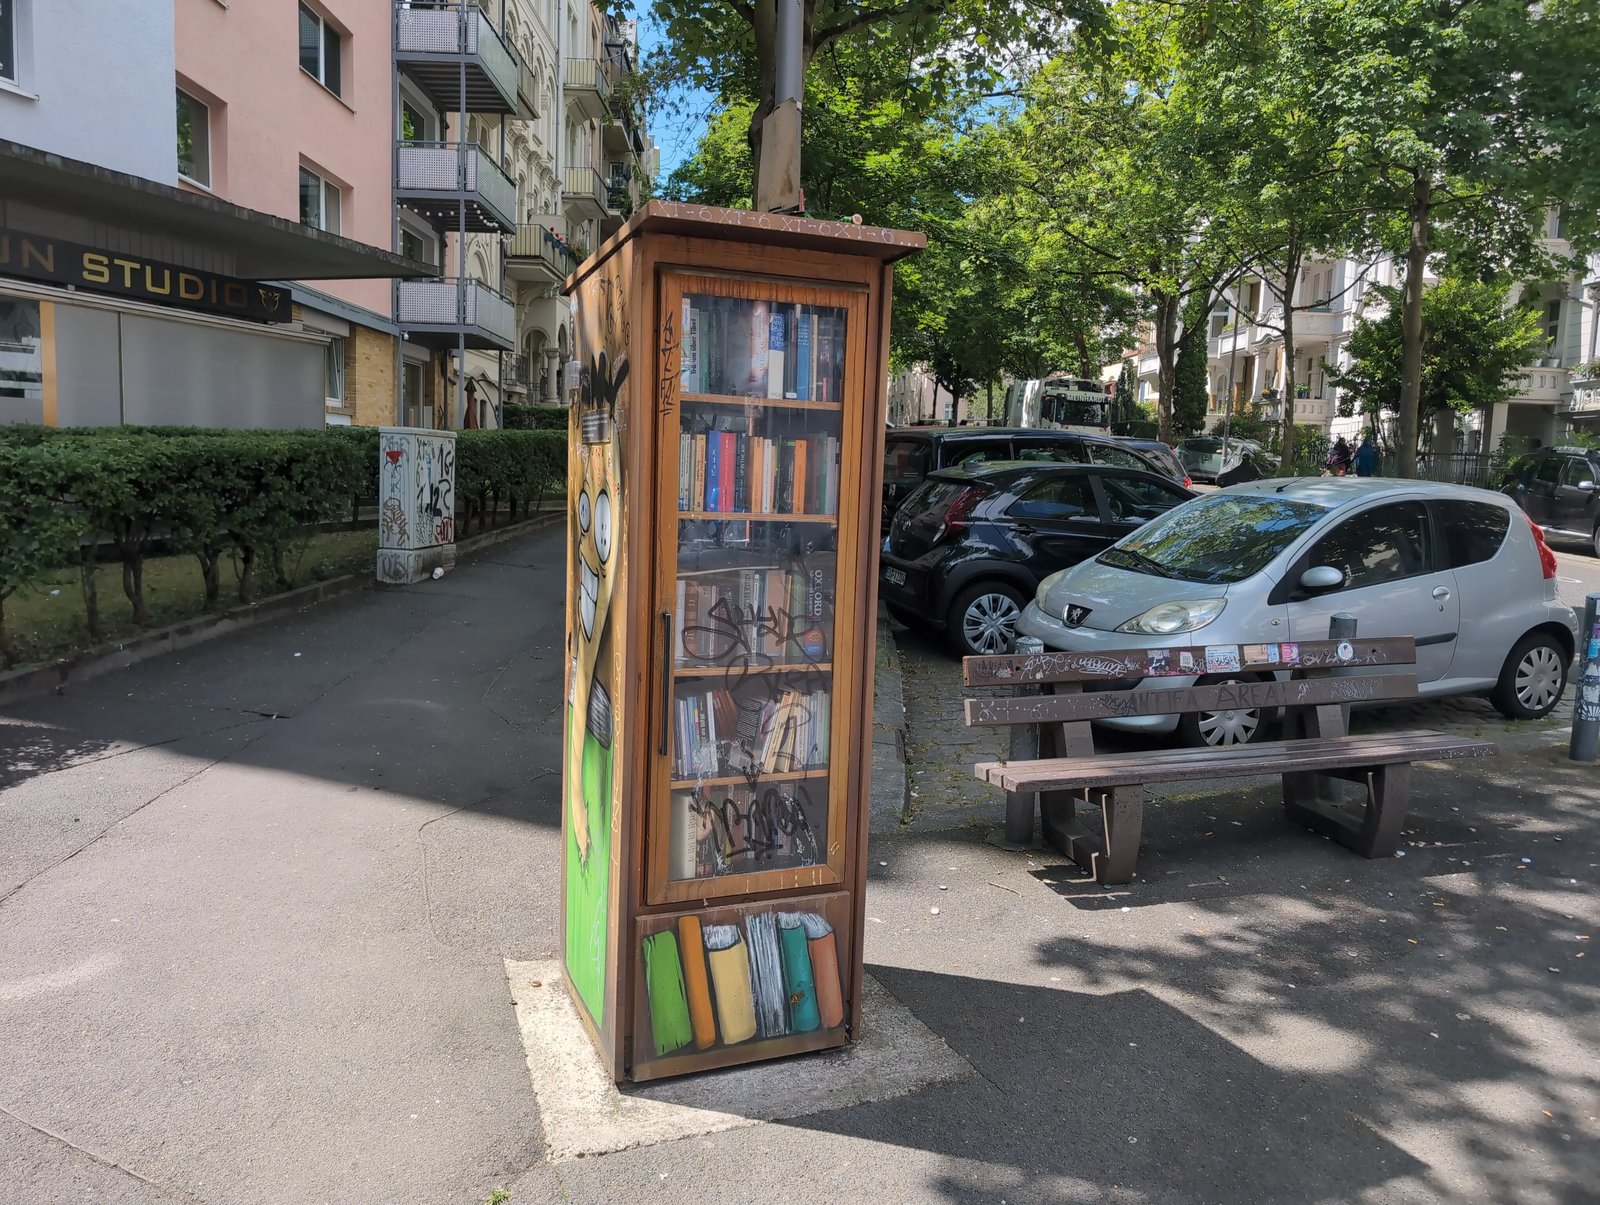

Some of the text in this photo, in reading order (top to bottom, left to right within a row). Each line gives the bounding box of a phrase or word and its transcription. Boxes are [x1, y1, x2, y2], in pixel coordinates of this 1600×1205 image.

[82, 252, 248, 310] STUDIO
[1067, 394, 1105, 403] MEINHARDT
[814, 569, 823, 617] OXFORD
[1129, 690, 1198, 717] ANTIFA
